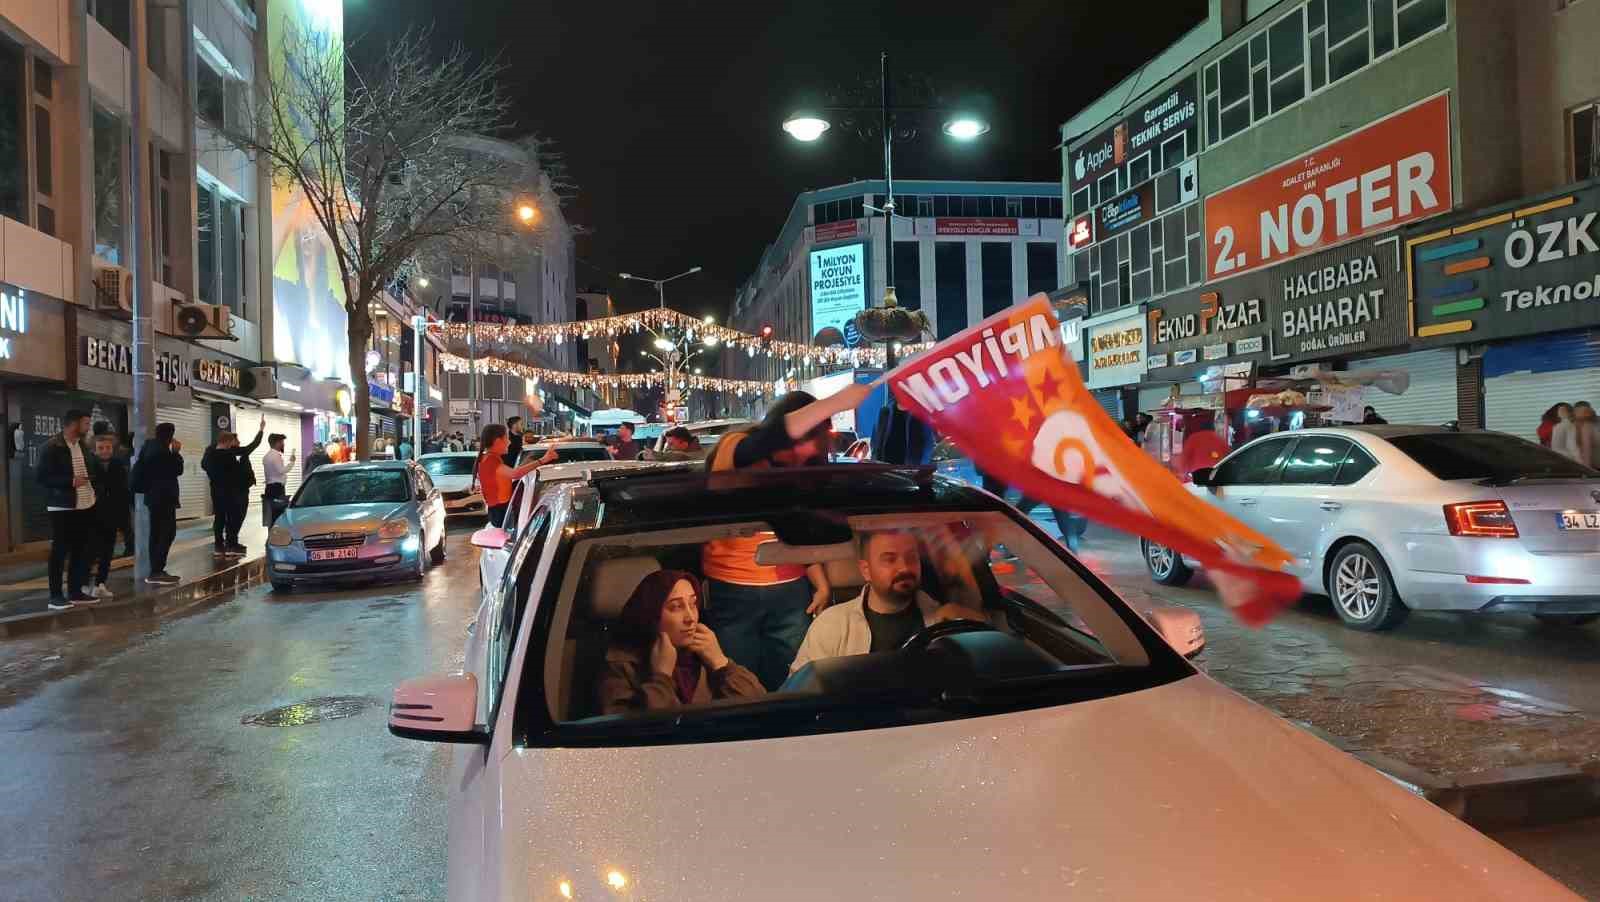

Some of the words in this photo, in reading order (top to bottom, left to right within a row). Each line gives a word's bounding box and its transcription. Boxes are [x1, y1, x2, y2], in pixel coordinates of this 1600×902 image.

[1144, 91, 1179, 123] Garantili
[1131, 121, 1161, 149] TEKNİK
[1163, 100, 1195, 131] SERVİS
[1087, 142, 1113, 172] Apple
[1282, 171, 1306, 188] ADALET
[1304, 178, 1317, 191] VAN
[1214, 225, 1247, 275] 2.
[1260, 151, 1439, 260] NOTER
[816, 255, 822, 268] 1
[823, 253, 856, 268] MİLYON
[821, 265, 853, 279] KOYUN
[814, 275, 861, 290] PROJESİYLE
[1284, 255, 1378, 301] HACIBABA
[1149, 309, 1195, 345] TEKNO
[1200, 292, 1261, 336] PAZAR
[1282, 288, 1384, 337] BAHARAT
[87, 336, 132, 374] BERA
[1301, 337, 1327, 352] DOĞAL
[1563, 514, 1580, 529] 34
